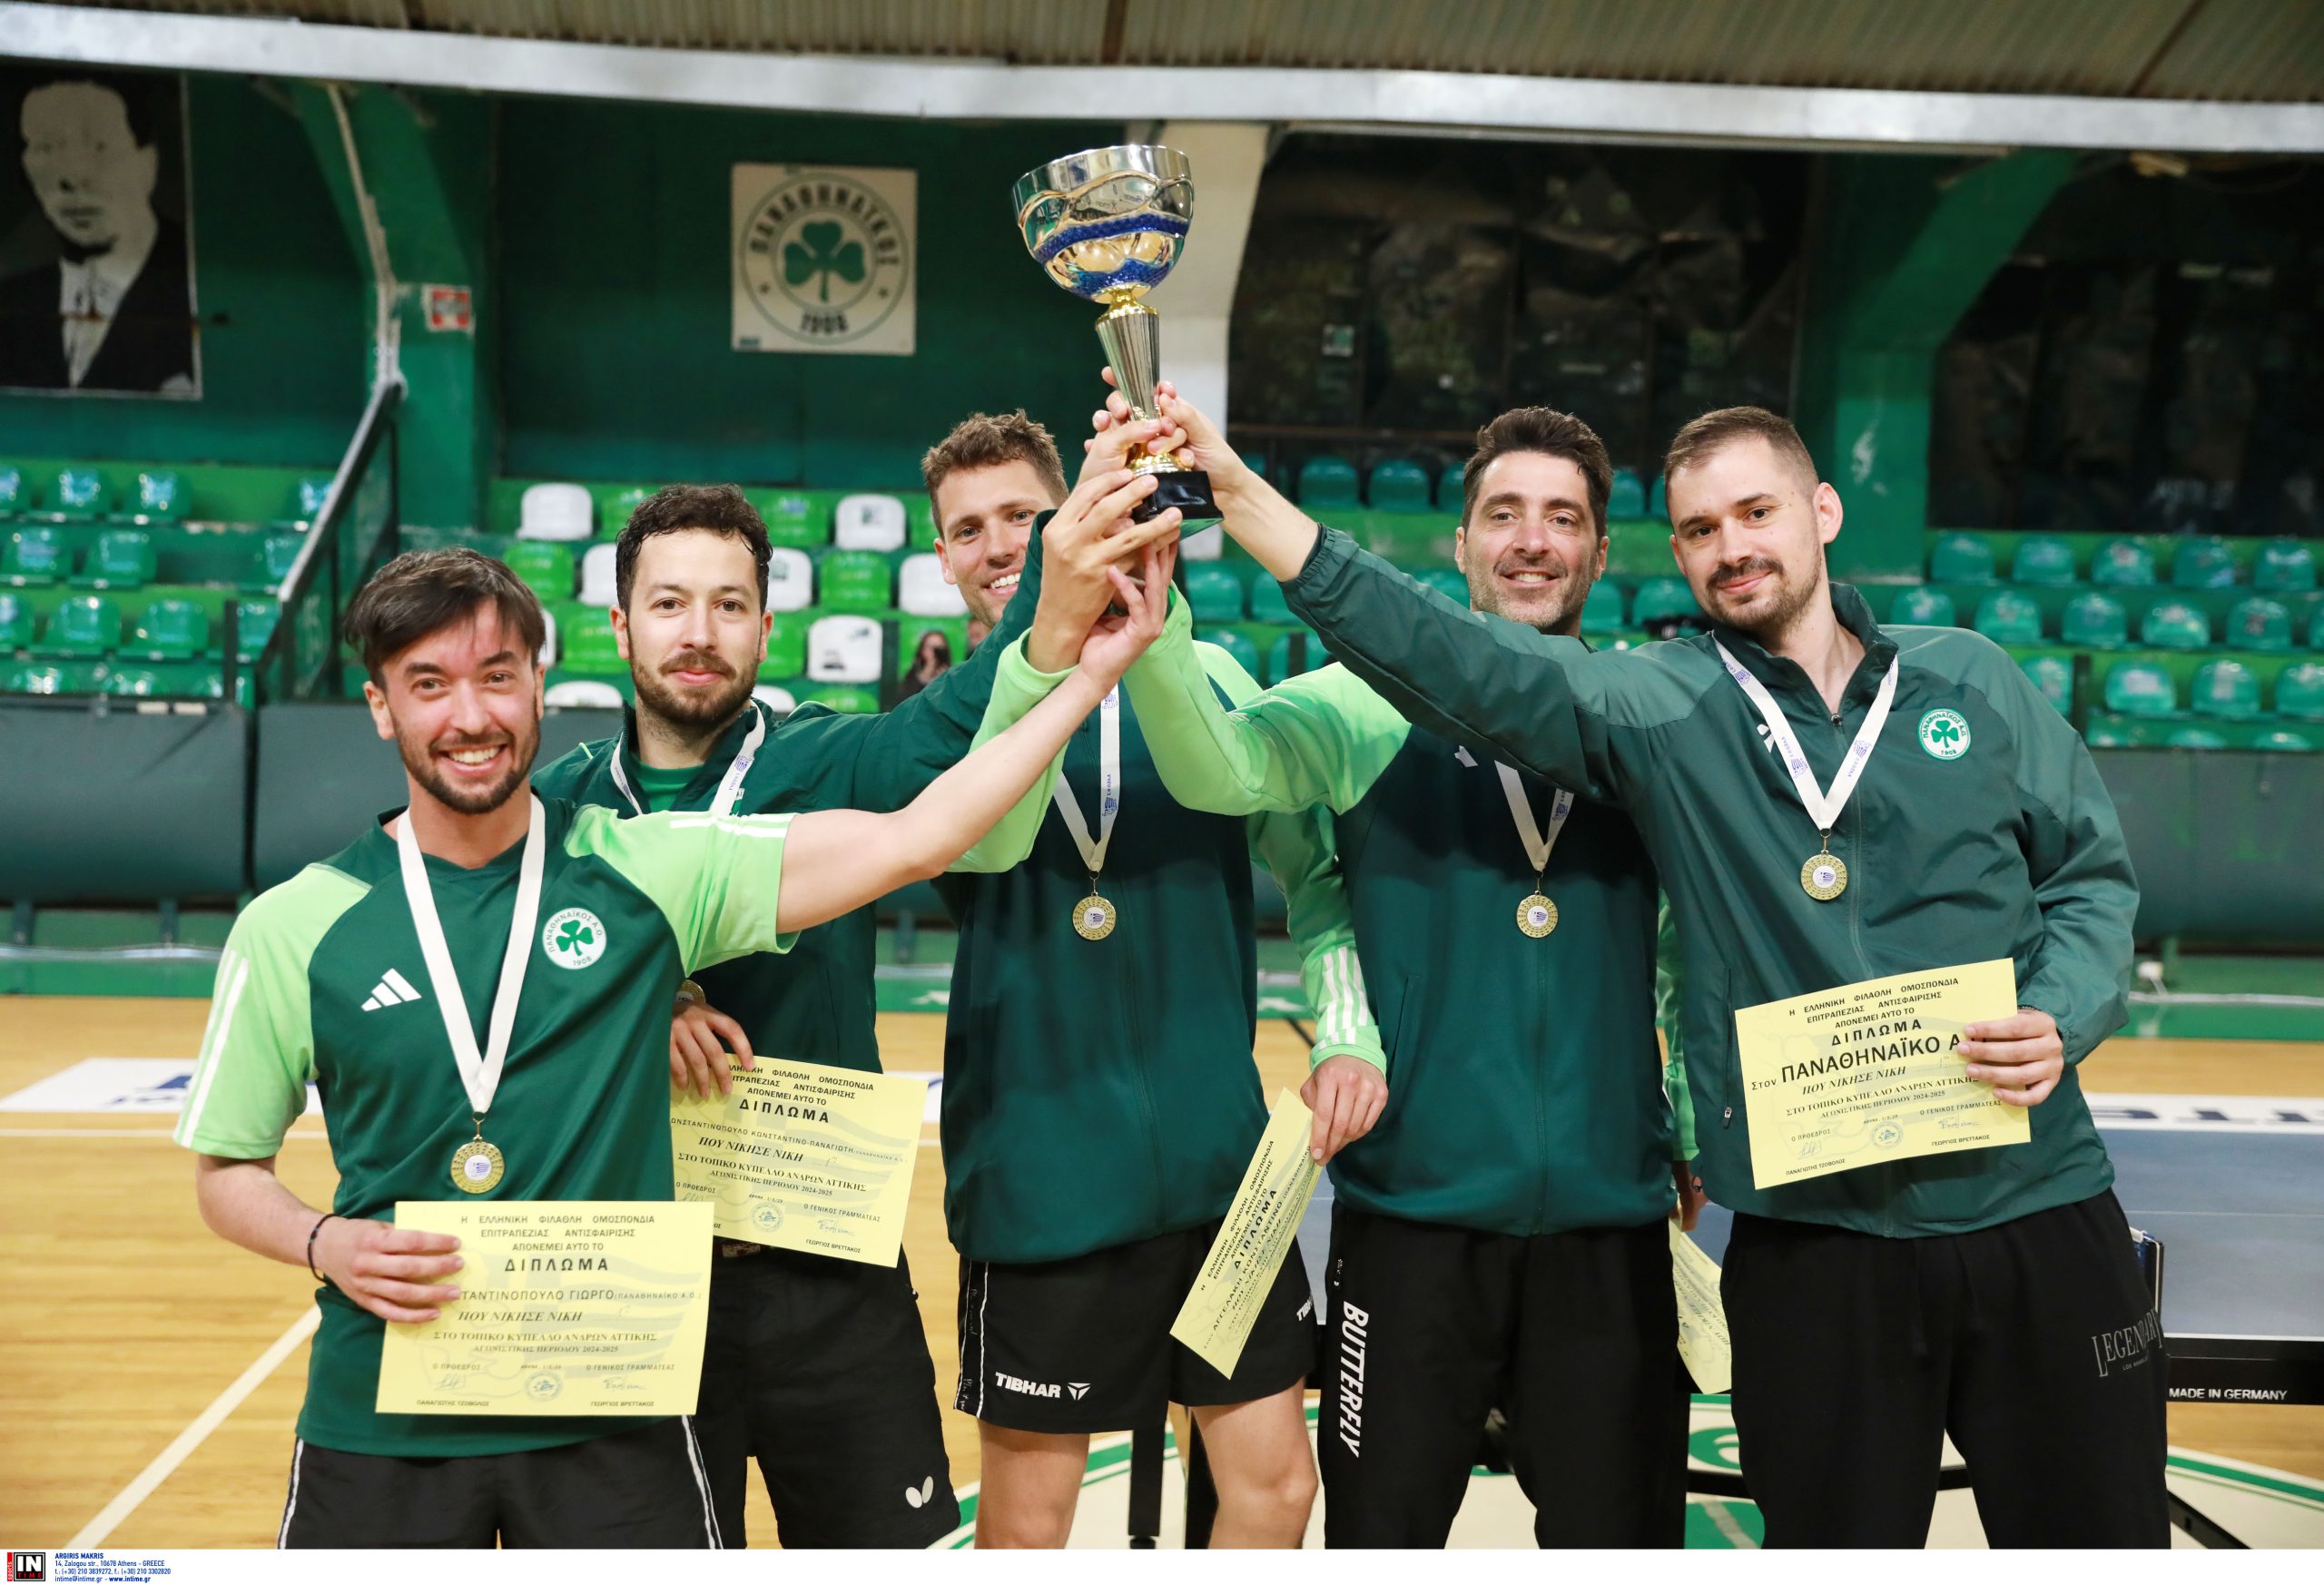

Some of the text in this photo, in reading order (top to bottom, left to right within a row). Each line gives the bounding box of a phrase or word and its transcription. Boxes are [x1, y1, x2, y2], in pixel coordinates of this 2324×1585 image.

[573, 956, 592, 966] 1908
[1804, 998, 1845, 1013] ΕΛΛΗΝΙΚΗ
[1854, 989, 1892, 1001] ΦΙΛΑΘΛΗ
[1901, 978, 1959, 993] ΟΜΟΣΠΟΝΔΙΑ
[1807, 991, 1942, 1024] ΕΠΙΤΡΑΠΕΖΙΑΣ ΑΝΤΙΣΦΑΙΡΙΣΗΣ
[1836, 1013, 1879, 1029] ΑΠΟΝΕΜΕΙ
[1881, 1009, 1902, 1019] ΑΥΤΟ
[1832, 1019, 1922, 1046] ΔΙΠΛΩΜΑ
[1752, 1078, 1777, 1091] Στον
[1781, 1037, 1940, 1082] ΠΑΝΑΘΗΝΑΪΚΟ
[733, 1076, 856, 1099] ΙΤΡΑΠΕΖΙΑΣ ΑΝΤΙΣΦΑΙΡΙΣΗΣ
[772, 1069, 810, 1080] ΦΙΛΑΘΛΗ
[819, 1077, 874, 1090] ΟΜΟΣΠΟΝΔΙΑ
[1803, 1066, 1906, 1095] ΠΟΥ ΝΙΚΗΣΕ ΝΙΚΗ
[747, 1088, 792, 1100] ΑΠΟΝΕΜΕΙ
[793, 1095, 814, 1104] ΑΥΤΟ
[1787, 1108, 1805, 1117] ΣΤΟ
[1808, 1098, 1844, 1111] ΤΟΠΙΚΟ
[1846, 1088, 1892, 1103] ΚΥΠΕΛΛΟ
[1894, 1080, 1933, 1093] ΑΝΔΡΩΝ
[1821, 1103, 1872, 1118] ΑΓΩΝΙΣΤΙΚΗΣ
[1873, 1096, 1911, 1108] ΠΕΡΙΟΔΟΥ
[1913, 1091, 1945, 1100] 2024-2025
[1926, 1106, 1955, 1115] ΓΕΝΙΚΟΣ
[1956, 1099, 2002, 1111] ΓΡΑΜΜΑΤΕΑΣ
[739, 1098, 829, 1123] ΔΙΠΛΩΜΑ
[671, 1117, 748, 1136] ΩΝΣΤΑΝΤΙΝΟΠΟΥΛΟ
[1797, 1129, 1830, 1140] ΠΡΟΕΔΡΟΣ
[699, 1137, 803, 1162] ΠΟΥ ΝΙΚΗΣΕ ΝΙΚΗ
[678, 1153, 867, 1192] ΣΤΟ ΤΟΠΙΚΟ ΚΥΠΕΛΛΟ ΑΝΔΡΩΝ ΑΤΤΙΚΗΣ
[710, 1170, 832, 1196] ΑΓΩΝΙΣΤΙΚΗΣ ΠΕΡΙΟΔΟΥ 2024-2025
[683, 1183, 715, 1193] ΠΡΟΕΔΡΟΣ
[479, 1216, 528, 1224] ΕΛΛΗΝΙΚΗ
[538, 1216, 582, 1224] ΦΙΛΑΘΛΗ
[592, 1216, 655, 1224] ΟΜΟΣΠΟΝΔΙΑ
[810, 1205, 837, 1215] ΓΕΝΙΚΟΣ
[839, 1209, 881, 1222] ΓΡΑΜΜΑΤΕΑΣ
[1207, 1238, 1228, 1277] ΕΛΛΗΝΙΚΗ
[1249, 1140, 1274, 1190] ΟΜΟΣΠΟΝΔΙΑ
[1214, 1227, 1241, 1279] ΕΠΙΤΡΑΠΕΖΙΑΣ
[1246, 1159, 1273, 1216] ΑΝΤΙΣΦΑΙΡΙΣΗΣ
[481, 1229, 635, 1237] ΕΠΙΤΡΑΠΕΖΙΑΣ ΑΝΤΙΣΦΑΙΡΙΣΗΣ
[1231, 1188, 1267, 1259] ΑΠΟΝΕΜΕΙ ΑΥΤΟ ΤΟ
[1235, 1190, 1276, 1269] ΔΙΠΛΩΜΑ
[512, 1243, 605, 1251] ΑΠΟΝΕΜΕΙ ΑΥΤΟ ΤΟ
[1243, 1201, 1282, 1275] ΚΩΝΣΤΑΝΤΙΝΟ
[505, 1258, 608, 1272] ΔΙΠΛΩΜΑ
[461, 1290, 564, 1301] ΤΑΝΤΙΝΟΠΟΥΛΟ
[568, 1289, 615, 1300] ΓΙΩΡΓΟ
[458, 1312, 583, 1322] ΠΟΥ ΝΙΚΗΣΕ ΝΙΚΗ
[434, 1331, 657, 1342] ΣΤΟ ΤΟΠΙΚΟ ΚΥΠΕΛΛΟ ΑΝΔΡΩΝ ΑΤΤΙΚΗΣ
[995, 1372, 1062, 1398] TIBHAR
[1340, 1301, 1369, 1458] BUTTERFLY
[2169, 1388, 2288, 1401] MADE IN GERMANY
